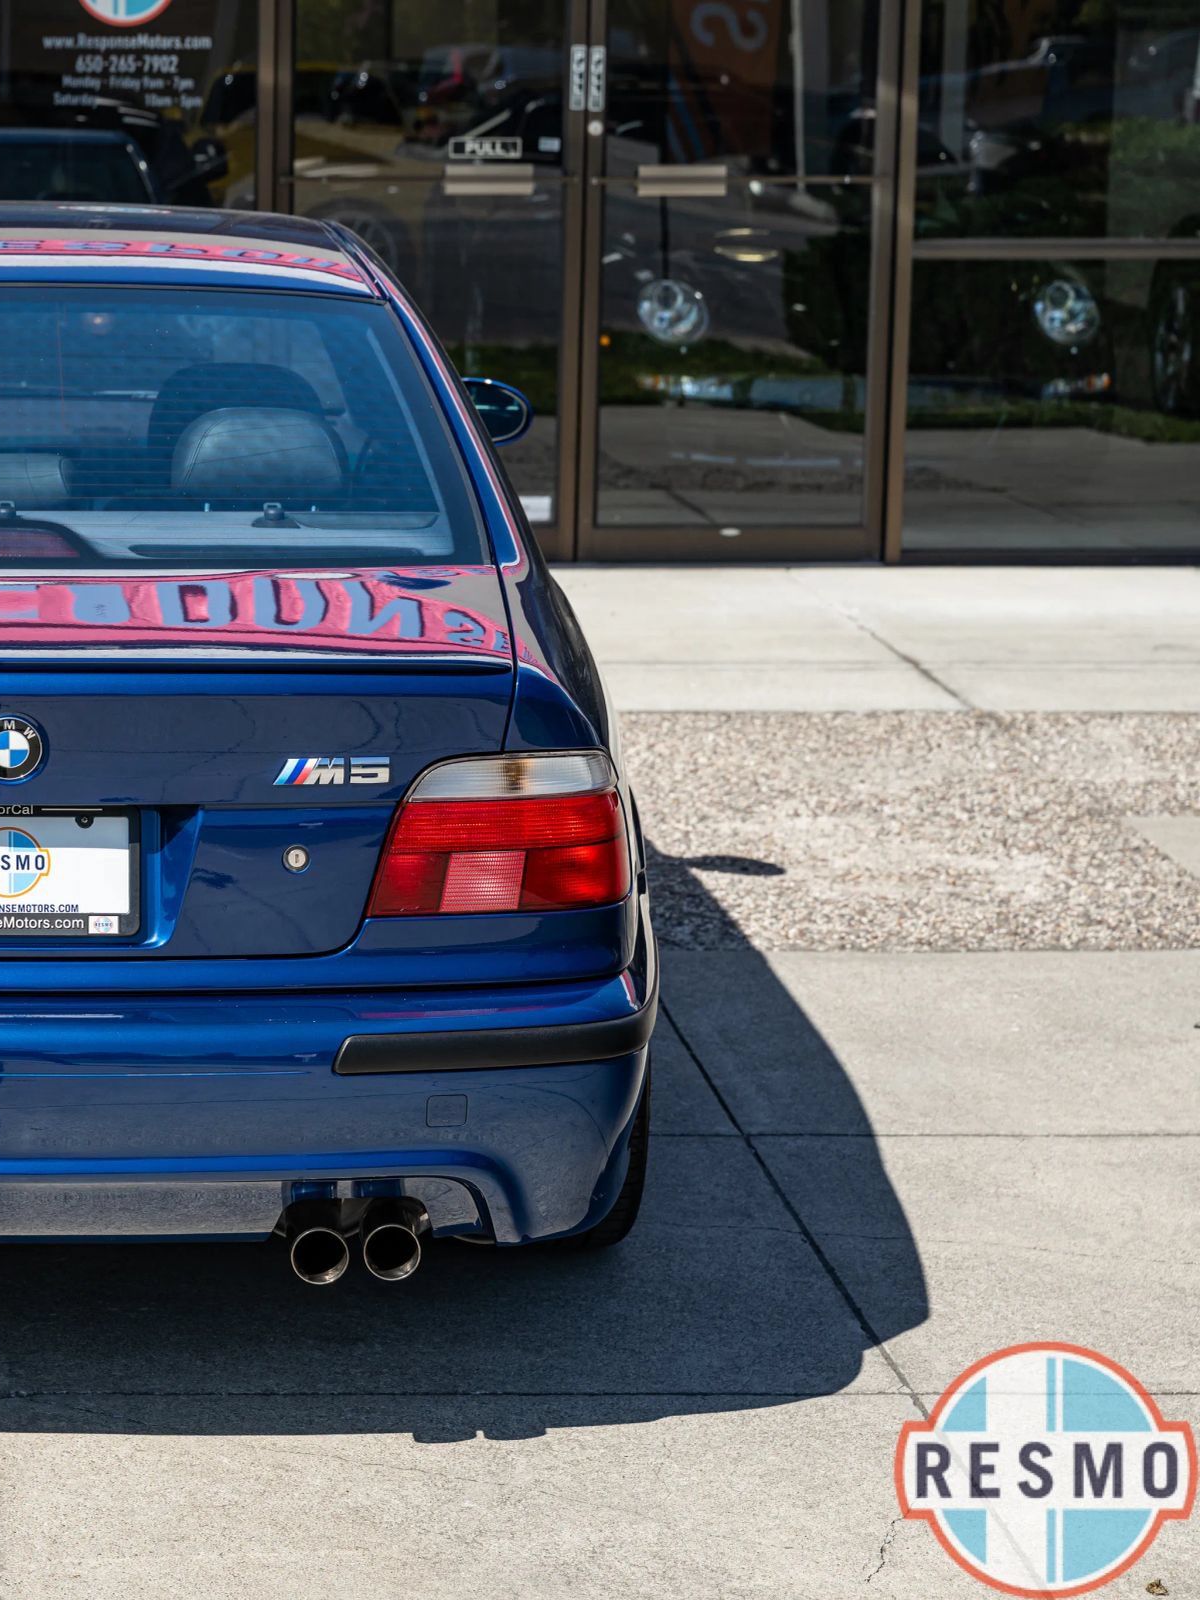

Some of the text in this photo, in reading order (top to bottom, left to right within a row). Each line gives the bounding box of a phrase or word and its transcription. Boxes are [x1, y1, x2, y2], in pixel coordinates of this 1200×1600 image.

[42, 33, 211, 52] www.ResponseMotors.com
[75, 55, 179, 73] 650-265-7902
[464, 141, 504, 156] PULL
[294, 757, 390, 785] M5
